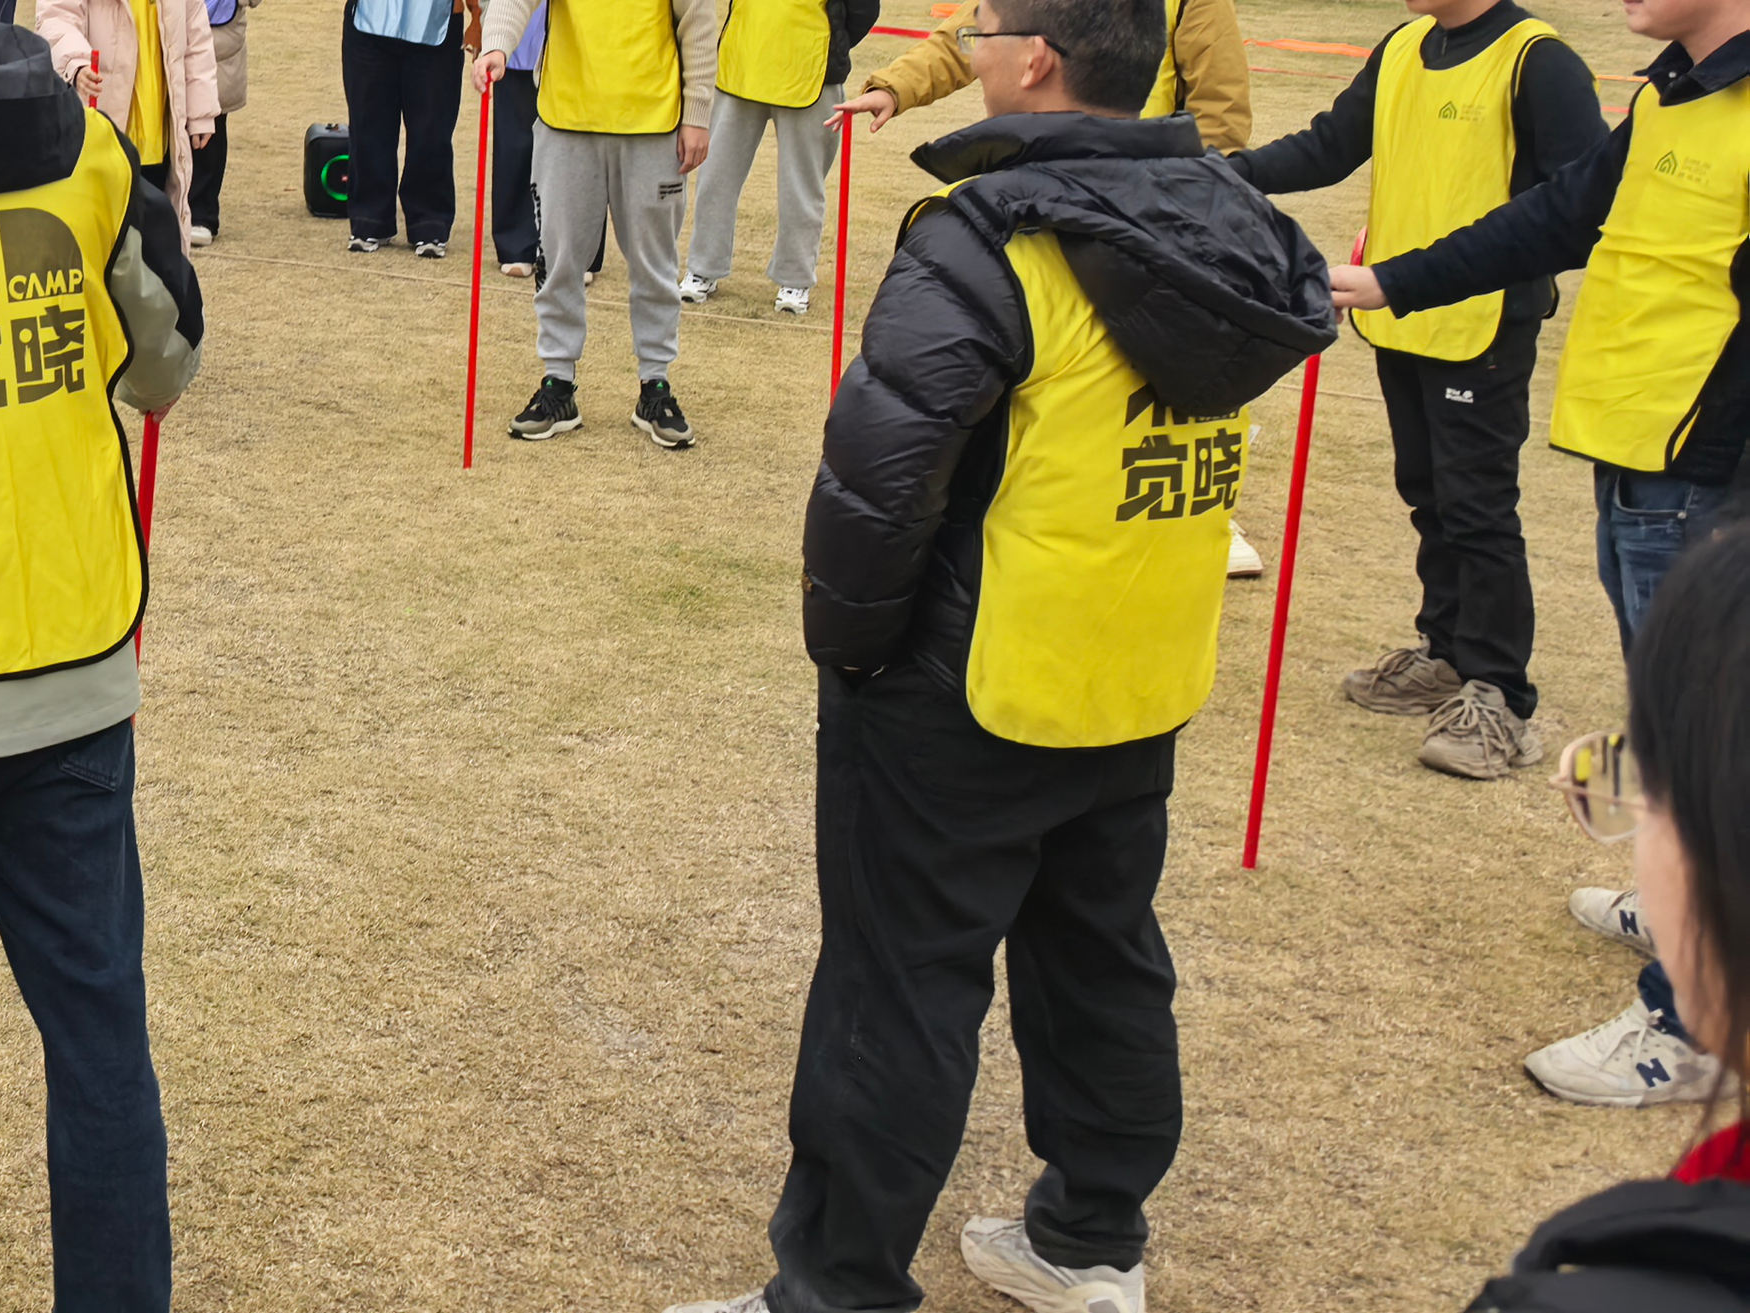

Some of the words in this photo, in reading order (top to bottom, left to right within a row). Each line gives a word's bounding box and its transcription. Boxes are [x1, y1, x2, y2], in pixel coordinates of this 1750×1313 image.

[8, 268, 84, 300] CAMP
[1115, 427, 1242, 522] 觉晓
[1618, 909, 1640, 936] N
[1635, 1057, 1671, 1088] N
